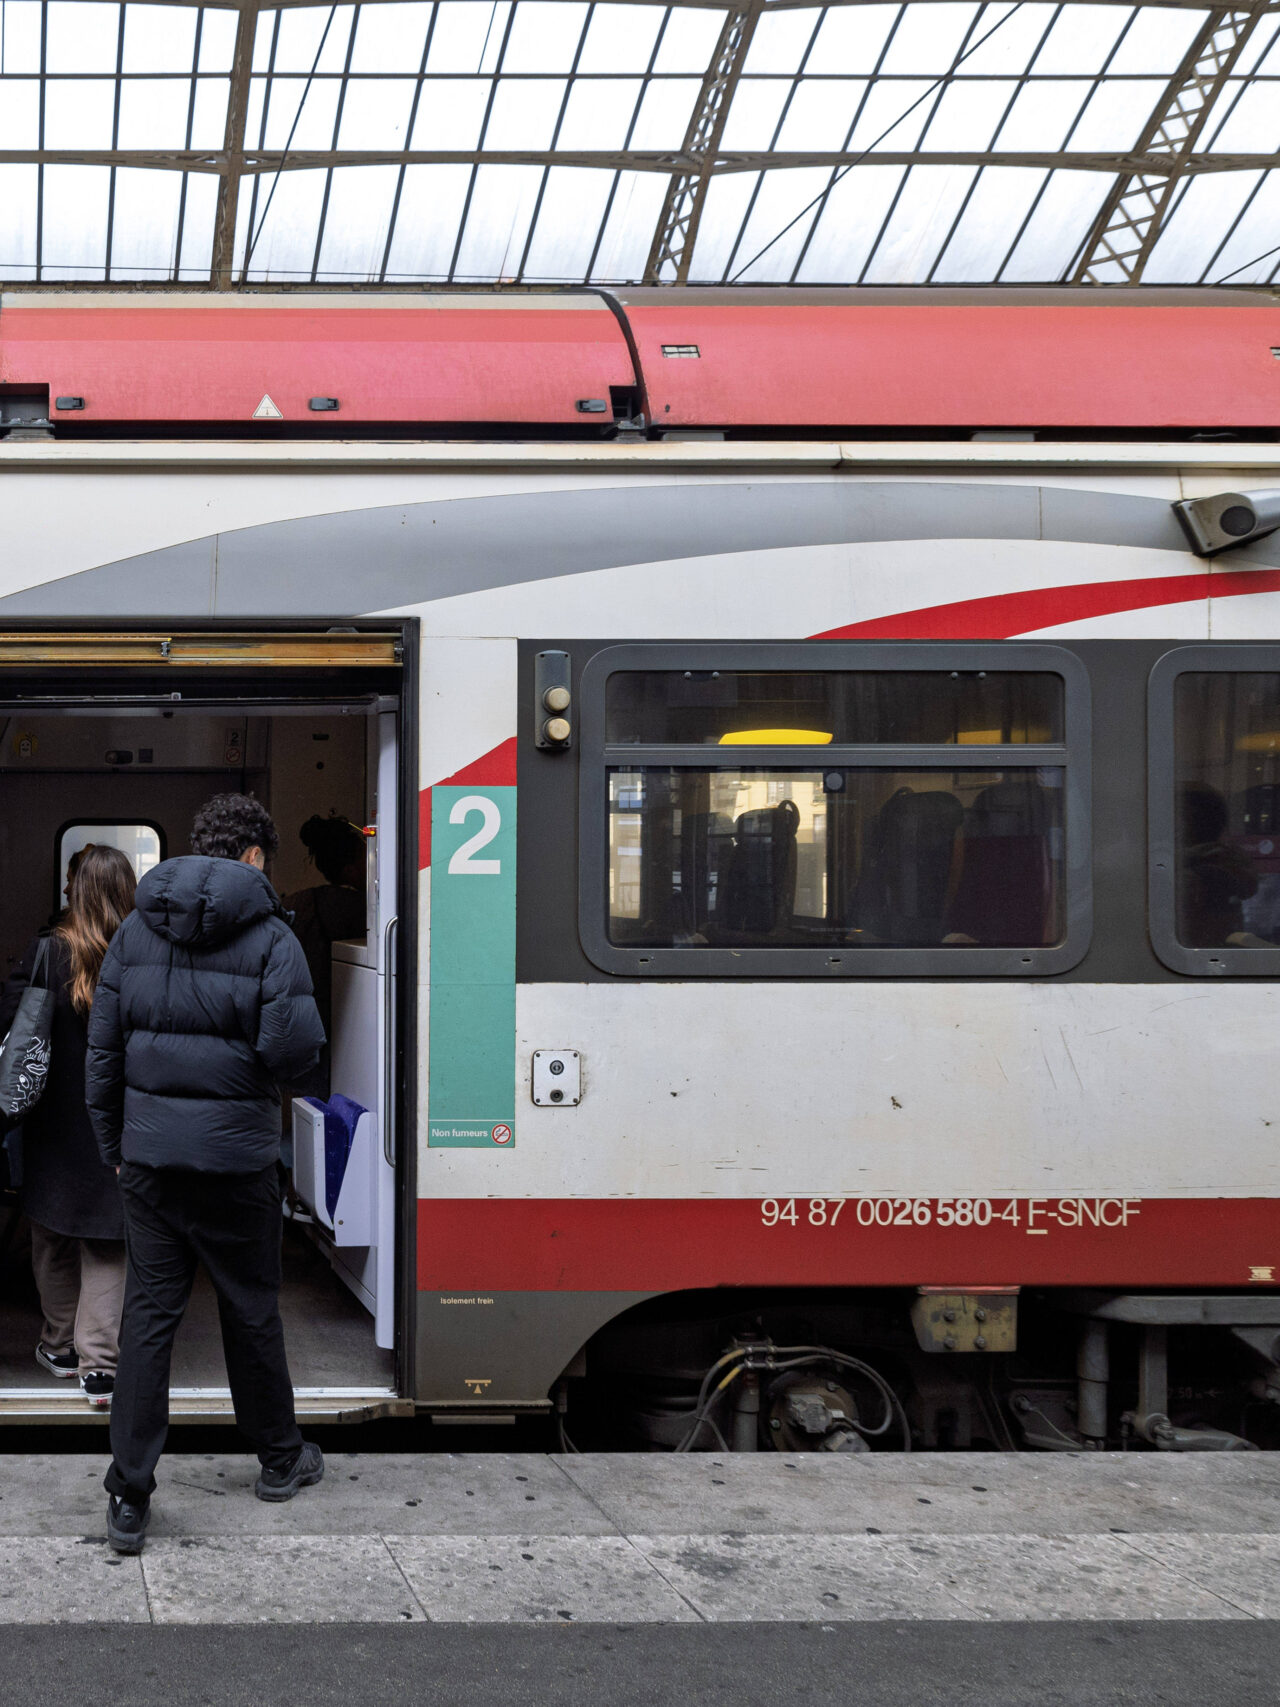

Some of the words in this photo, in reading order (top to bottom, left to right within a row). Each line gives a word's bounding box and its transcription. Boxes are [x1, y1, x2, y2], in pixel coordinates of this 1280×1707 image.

[448, 795, 501, 875] 2
[431, 1128, 451, 1137] Non
[452, 1128, 489, 1137] fumeurs
[761, 1199, 800, 1227] 94
[808, 1199, 846, 1227] 87
[856, 1199, 932, 1227] 0026
[936, 1199, 1021, 1227] 580-4
[1027, 1199, 1142, 1230] F-SNCF
[440, 1297, 476, 1305] Isolement
[477, 1297, 494, 1305] frein
